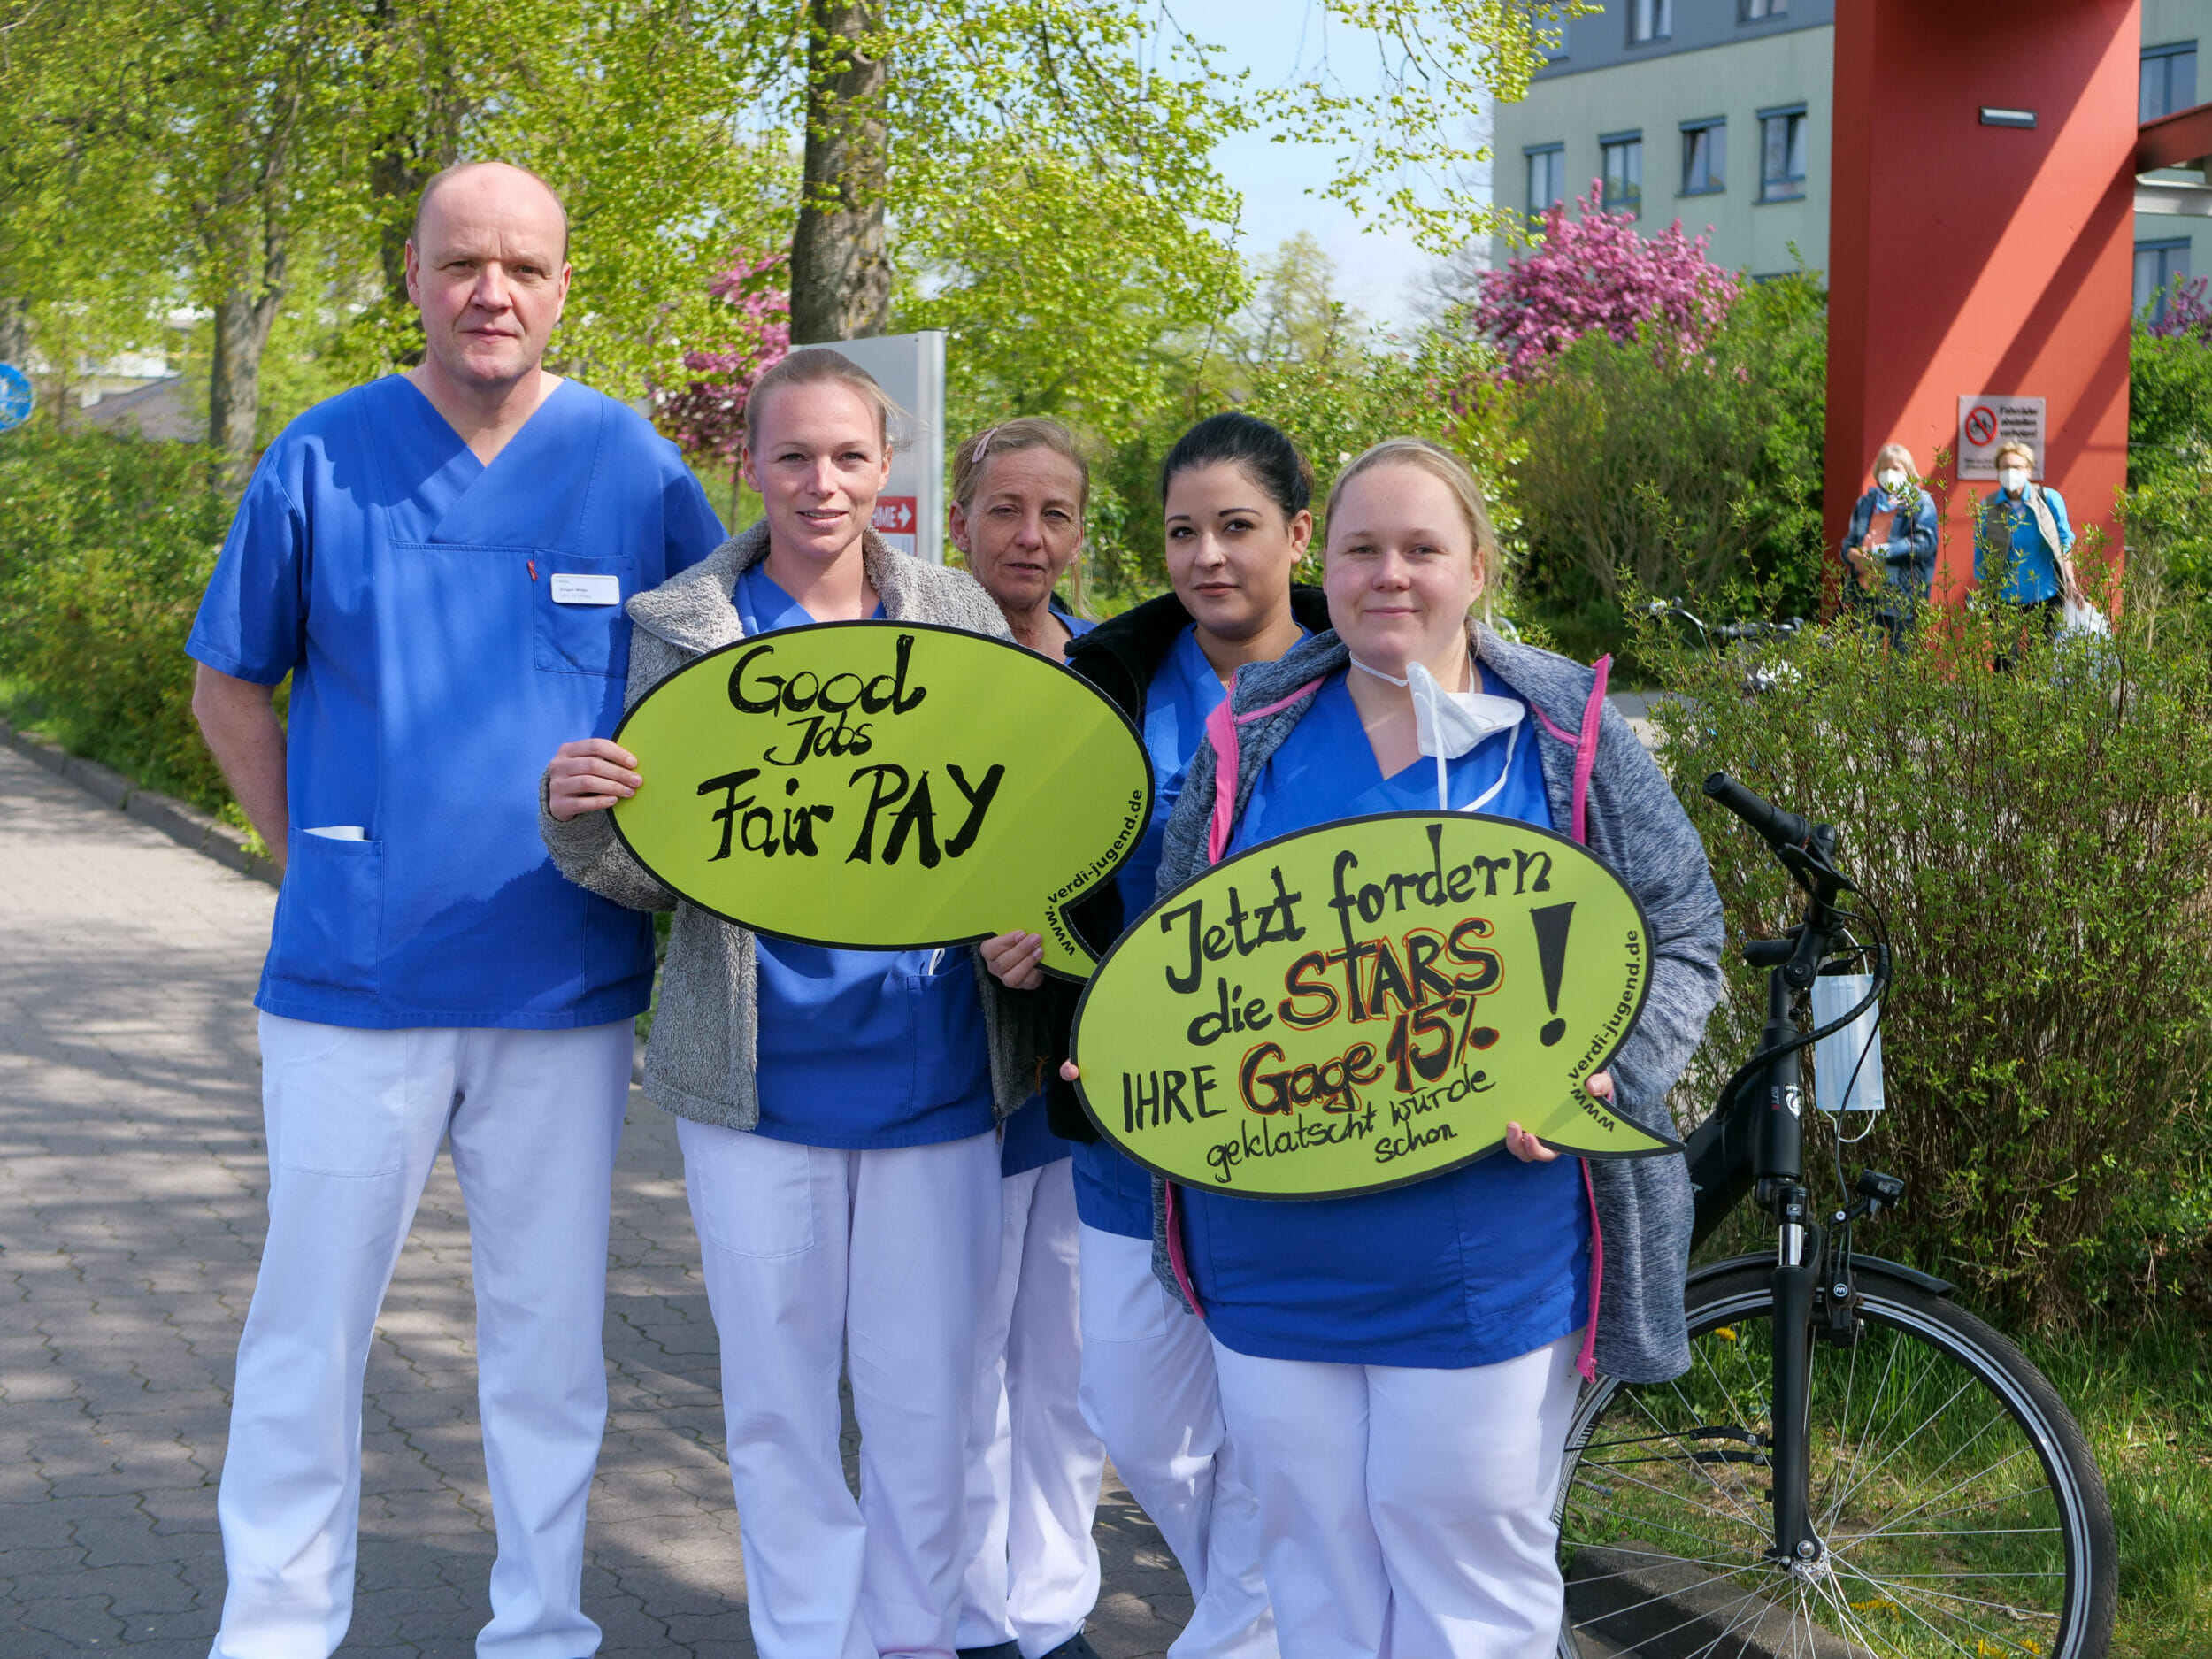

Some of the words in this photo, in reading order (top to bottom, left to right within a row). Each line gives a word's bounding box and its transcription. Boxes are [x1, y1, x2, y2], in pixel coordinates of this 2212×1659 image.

[728, 634, 926, 716] Good
[763, 710, 872, 765] Jobs
[696, 768, 833, 862] Fair
[845, 764, 1005, 869] PAY
[1045, 790, 1142, 956] www.verdi-jugend.de
[1160, 866, 1306, 994] Jetzt
[1328, 824, 1553, 946] fordern
[1187, 978, 1273, 1046] die
[1279, 918, 1503, 1030] STARS
[1568, 930, 1640, 1133] www.verdi-jugend.de
[1123, 1065, 1226, 1133] IHRE
[1239, 1041, 1385, 1115] Gage
[1386, 995, 1499, 1093] 15%
[1206, 1101, 1378, 1182] geklatscht
[1390, 1063, 1496, 1126] würde
[1375, 1120, 1458, 1163] schon
